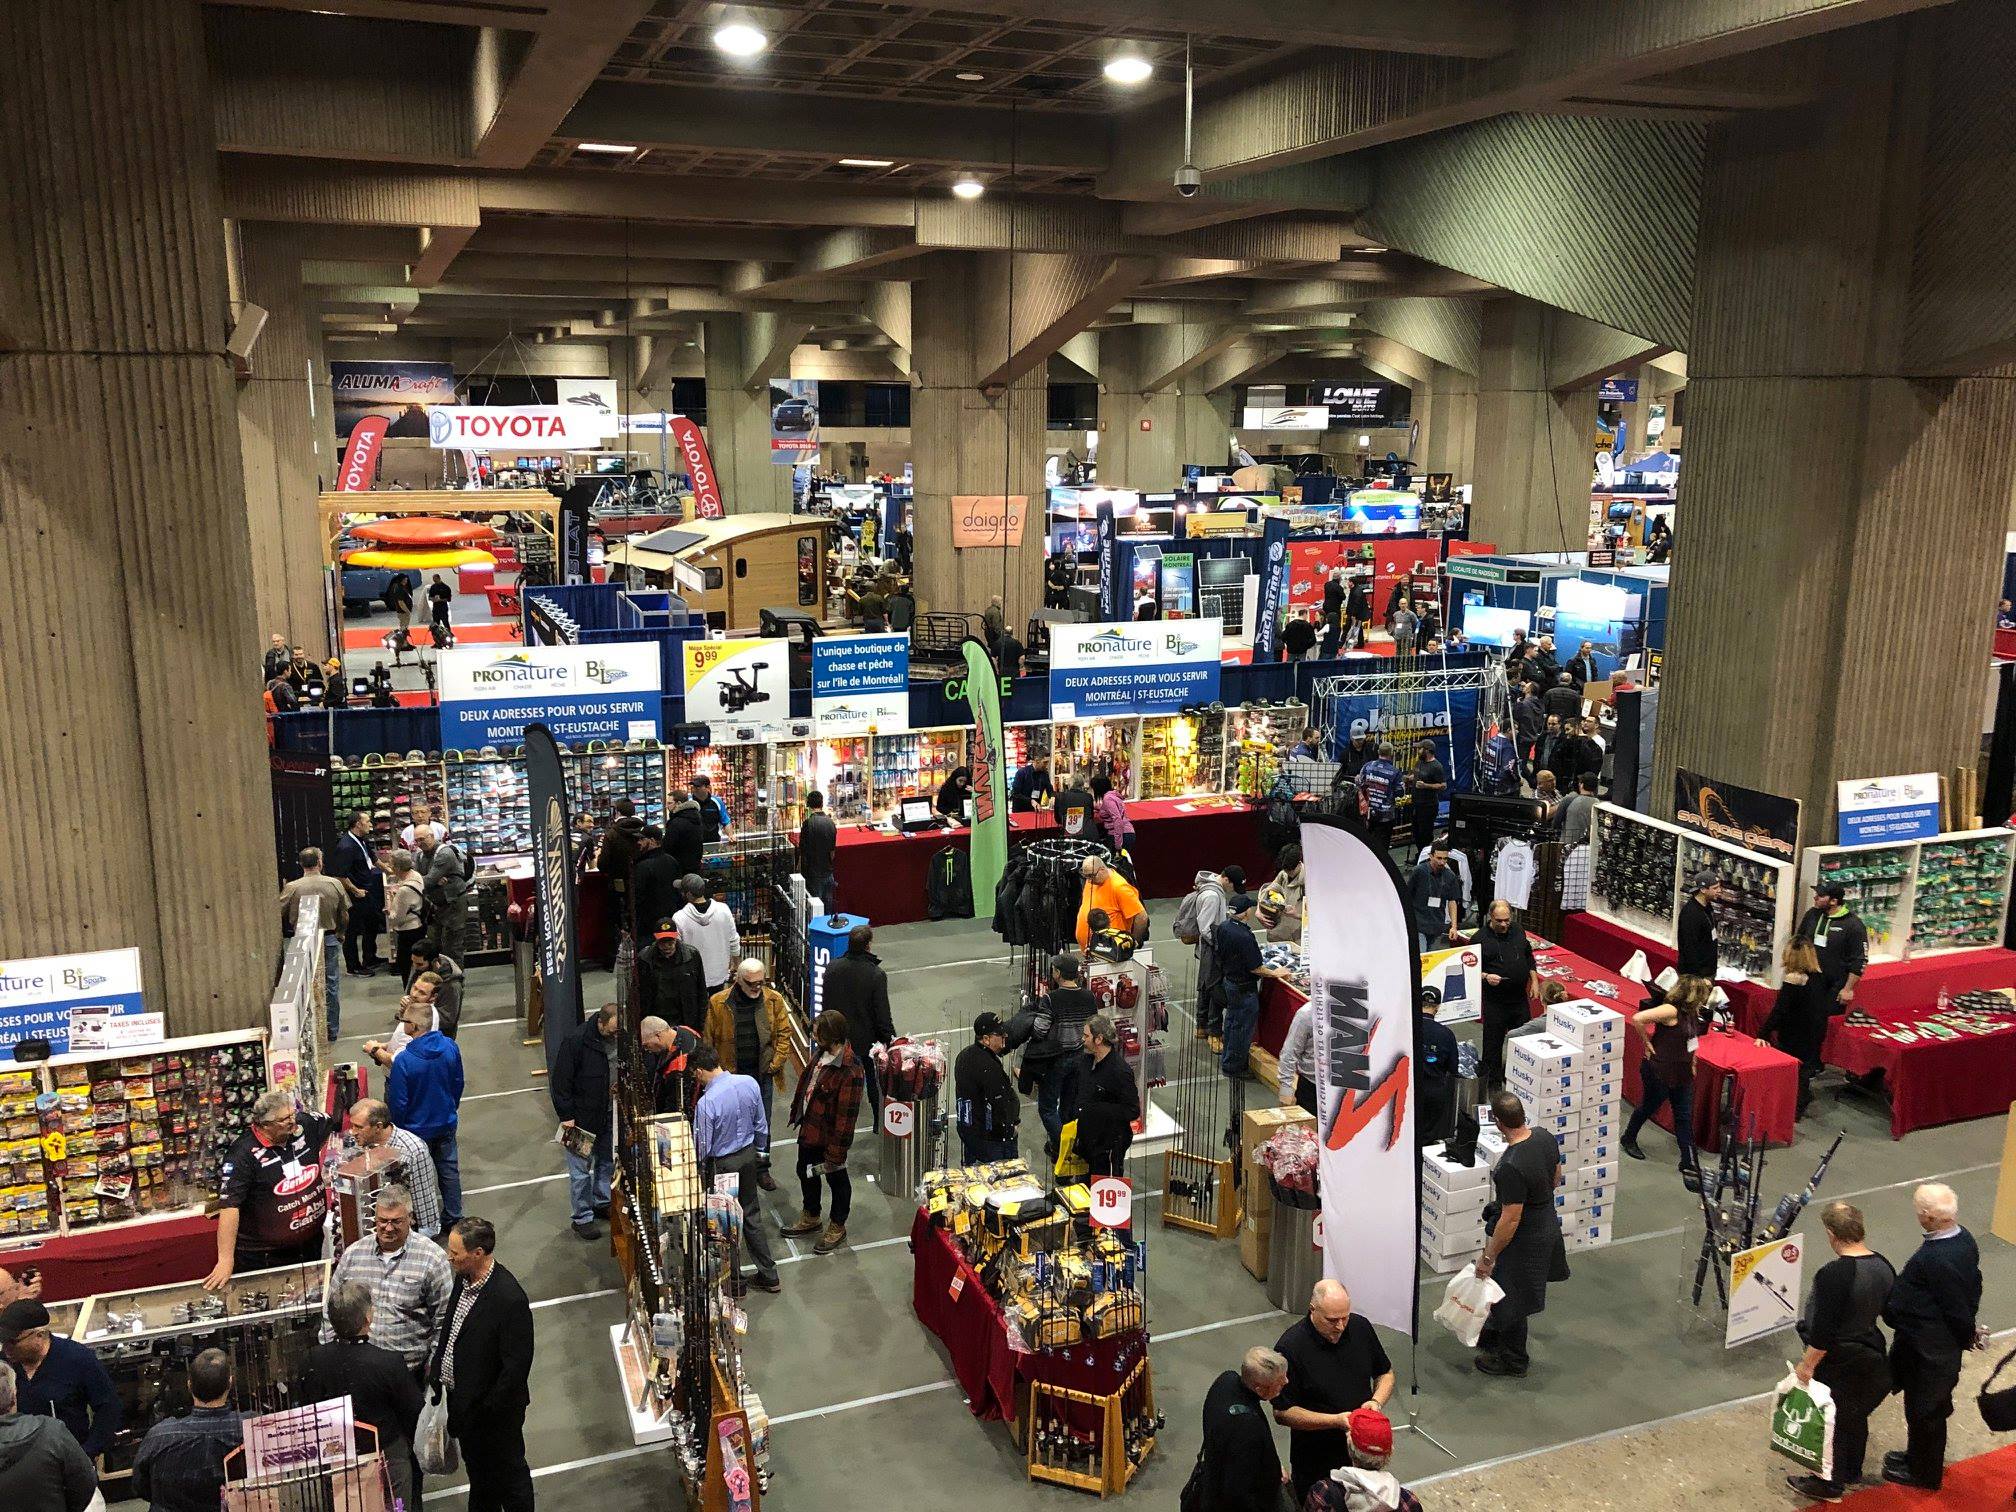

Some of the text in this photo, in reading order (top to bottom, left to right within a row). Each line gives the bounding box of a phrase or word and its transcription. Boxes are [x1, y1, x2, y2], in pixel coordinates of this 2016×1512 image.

[1322, 388, 1381, 404] LOWE
[455, 415, 566, 437] TOYOTA
[683, 430, 709, 493] TOYOTA
[817, 642, 905, 658] L'unique boutique de
[1078, 638, 1152, 653] PROnature
[472, 663, 568, 683] PROnature
[828, 658, 893, 672] chasse et pêche
[817, 680, 831, 689] sur
[850, 675, 860, 686] de
[862, 673, 904, 685] Montréal!
[1065, 670, 1208, 688] DEUX ADRESSES POUR VOUS SERVIR
[1085, 688, 1131, 702] MONTRÉAL
[1138, 687, 1189, 700] ST-EUSTACHE
[460, 701, 644, 722] DEUX ADRESSES POUR VOUS SERVIR
[554, 720, 620, 735] ST-EUSTACHE
[1678, 810, 1793, 856] SAVAGE GEAR
[25, 1012, 54, 1025] POUR
[1553, 1014, 1576, 1034] Husky
[1514, 1047, 1536, 1067] Husky
[1512, 1066, 1534, 1085] Husky
[1513, 1084, 1534, 1104] Husky
[277, 1200, 300, 1213] Catch
